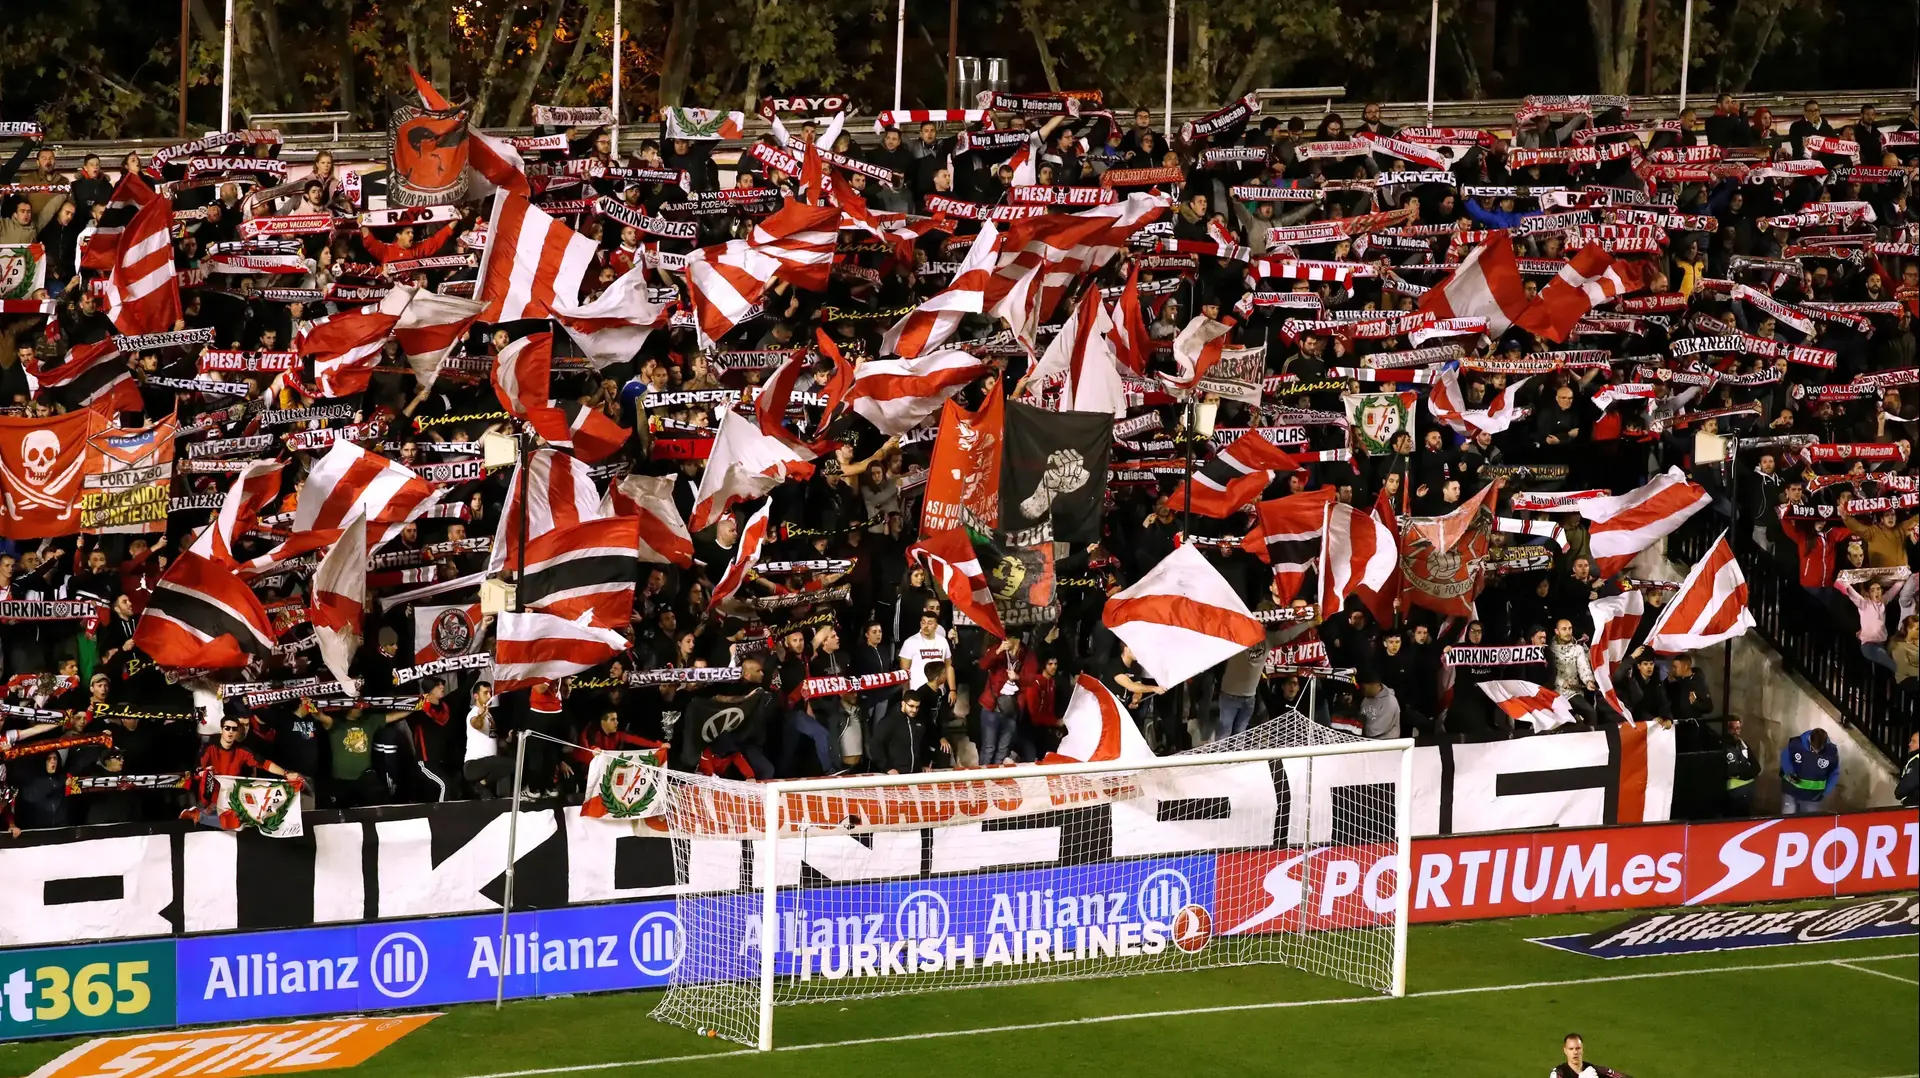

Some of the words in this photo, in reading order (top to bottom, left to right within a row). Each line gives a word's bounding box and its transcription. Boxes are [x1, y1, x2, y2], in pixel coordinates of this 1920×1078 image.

[774, 96, 844, 111] RAYO
[159, 131, 242, 163] BUKANEROS
[753, 143, 797, 173] PRESA
[787, 137, 831, 160] EQUPO
[1836, 168, 1858, 177] RAYO
[1859, 168, 1905, 178] VALLECANO
[701, 191, 726, 200] RAYO
[725, 187, 778, 199] VALLECANO
[1014, 186, 1052, 202] PRESA
[1070, 187, 1099, 202] VETE
[387, 208, 434, 224] RAYO
[930, 193, 972, 217] PRESA
[992, 201, 1024, 218] VETE
[1278, 230, 1295, 241] RAYO
[1355, 322, 1387, 338] PRESA
[1399, 314, 1425, 332] VETE
[202, 351, 242, 370] PRESA
[260, 352, 292, 369] VETE
[1745, 336, 1777, 357] RESA
[1792, 349, 1823, 365] VETE
[644, 388, 741, 410] BUKANEROS
[1199, 381, 1245, 396] VALLEKAS
[1806, 385, 1827, 395] RAYO
[1827, 384, 1876, 395] VALLECANO
[1813, 446, 1835, 457] Rayo
[1855, 446, 1894, 457] Vallecano
[99, 466, 163, 488] PORTAZGO
[82, 483, 172, 511] BIENVENIDOS
[1847, 497, 1886, 513] PRESA
[81, 510, 96, 528] AL
[1793, 503, 1815, 516] Rayo
[1005, 520, 1055, 548] LOVE
[1448, 646, 1498, 666] WORKING
[400, 652, 491, 684] BUKANEROS
[808, 678, 848, 696] PRESA
[864, 673, 892, 689] VETE
[892, 670, 910, 683] YA
[988, 886, 1128, 932] Allianz
[1590, 908, 1829, 950] Allianz
[467, 930, 620, 980] Allianz
[798, 936, 976, 982] TURKISH
[982, 920, 1168, 968] AIRLINES
[203, 953, 360, 1001] Allianz
[0, 959, 152, 1023] t365
[98, 1022, 369, 1076] STIHL
